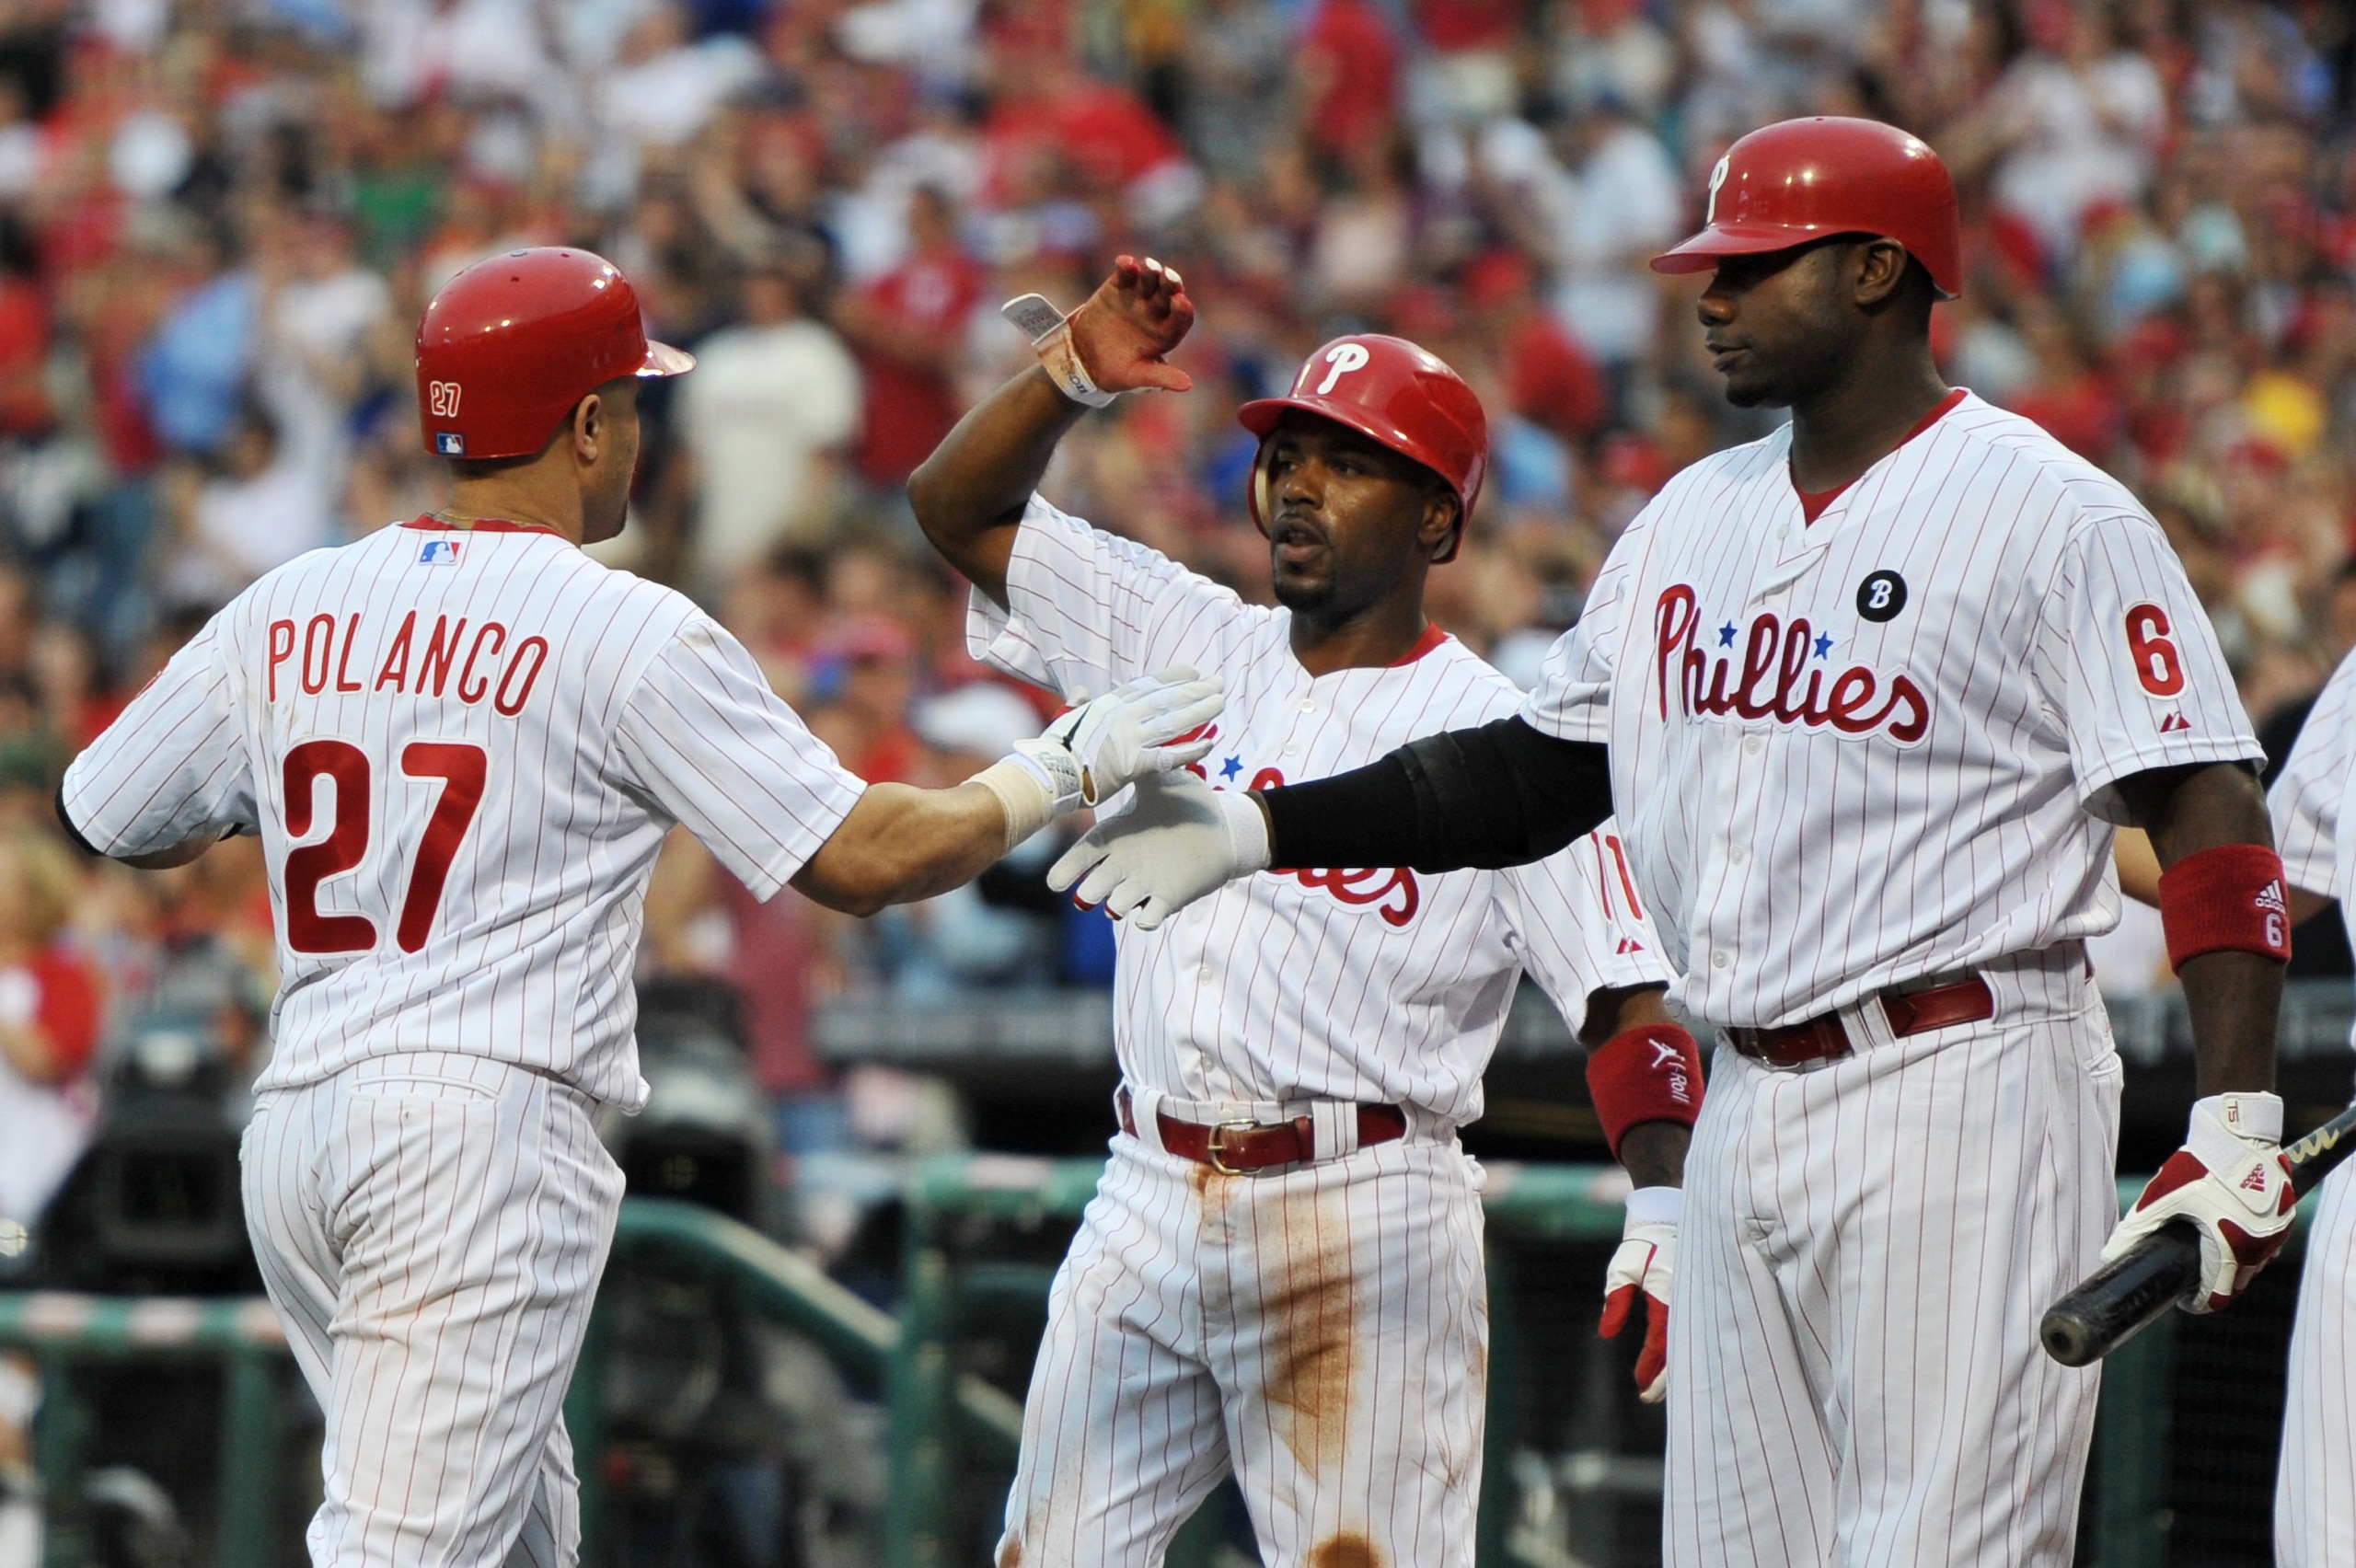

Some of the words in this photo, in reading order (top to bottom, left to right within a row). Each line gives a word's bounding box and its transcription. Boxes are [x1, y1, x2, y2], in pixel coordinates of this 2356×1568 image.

[1708, 156, 1730, 224] P
[430, 380, 461, 418] 27
[1317, 343, 1369, 395] P
[1868, 579, 1893, 609] B
[269, 610, 549, 718] POLANCO
[1654, 582, 1930, 743] Phillies
[2125, 604, 2185, 697] 6
[283, 740, 488, 954] 27
[1590, 830, 1644, 920] 11
[2266, 912, 2282, 948] 6
